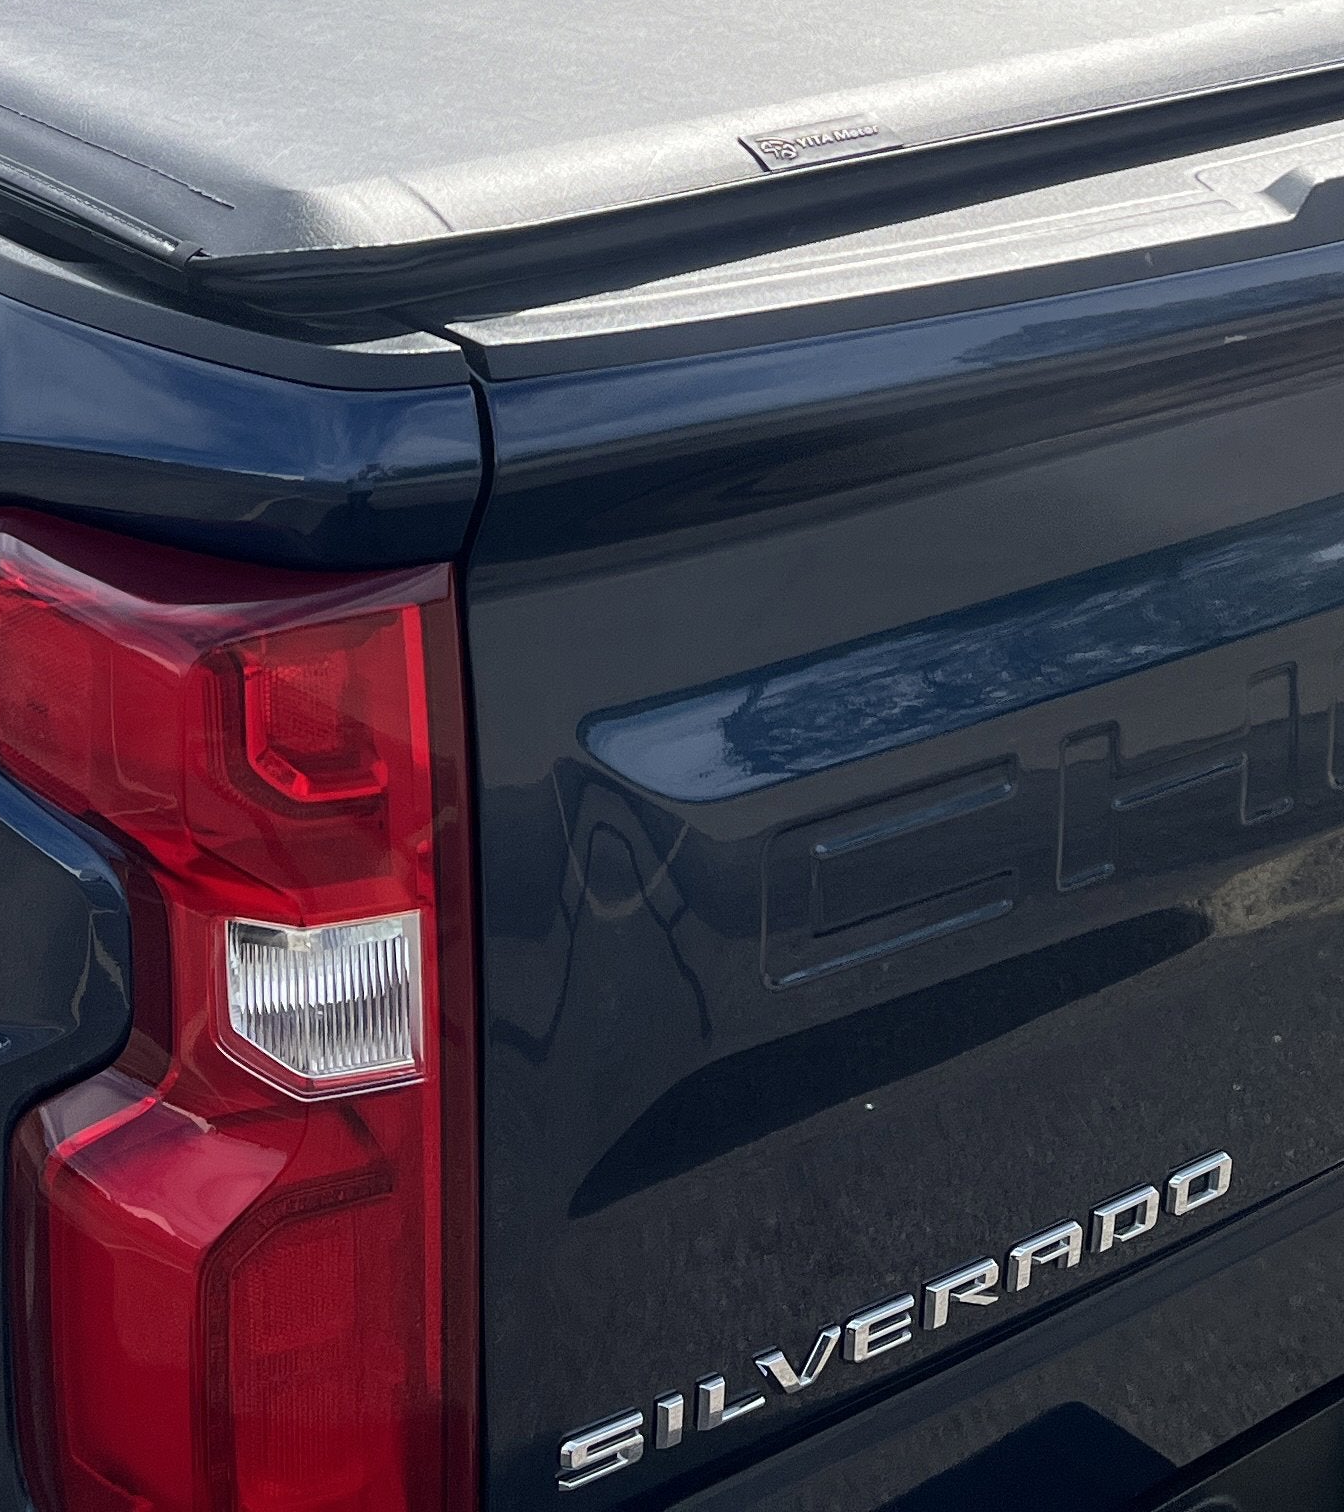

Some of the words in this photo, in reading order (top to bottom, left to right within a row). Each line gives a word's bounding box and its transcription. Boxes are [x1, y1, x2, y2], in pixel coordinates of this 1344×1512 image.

[796, 133, 834, 149] YITA
[833, 124, 880, 142] Motor
[556, 1149, 1233, 1492] SILVERADO
